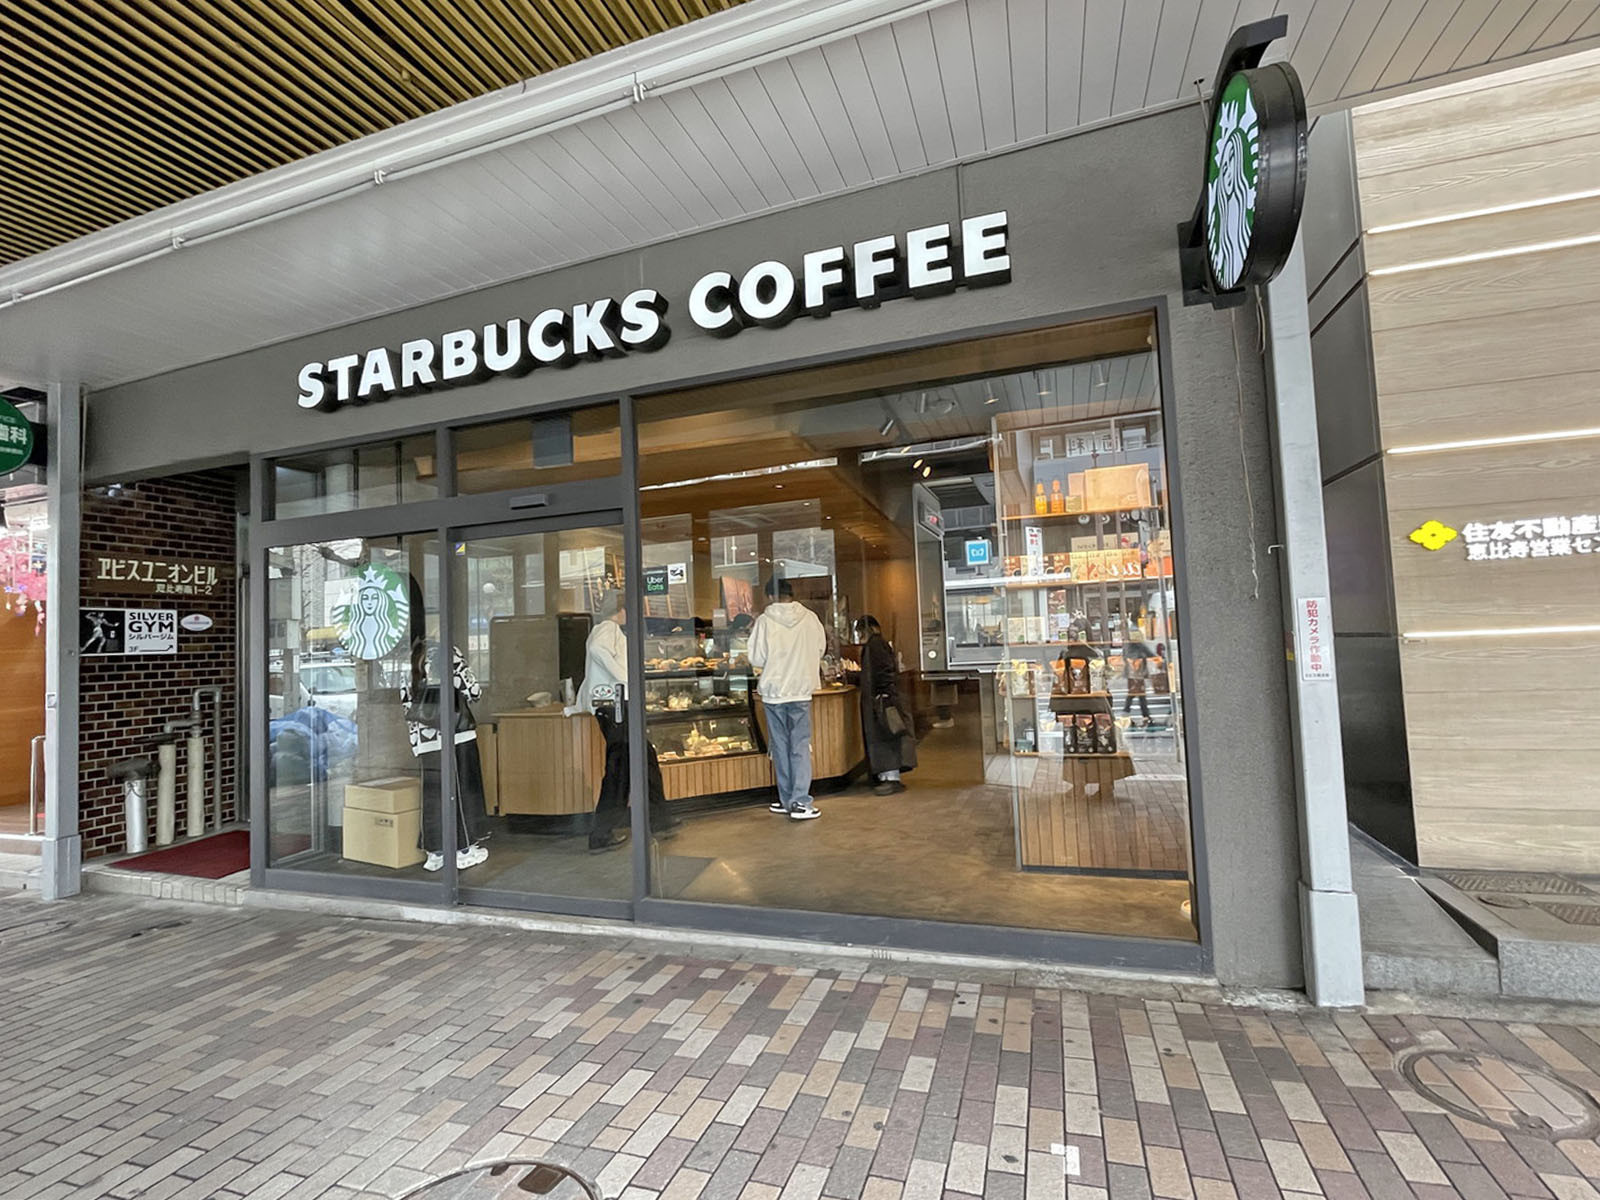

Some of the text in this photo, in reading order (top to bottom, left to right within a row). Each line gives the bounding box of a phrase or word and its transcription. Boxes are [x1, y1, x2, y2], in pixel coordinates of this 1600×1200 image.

[298, 210, 1011, 410] STARBUCKS COFFEE
[1462, 515, 1600, 543] 住友不動産
[646, 576, 664, 584] Uber
[647, 584, 664, 592] Eats
[128, 612, 174, 621] SILVER
[128, 621, 174, 633] GYM
[1306, 600, 1322, 672] 防犯カメラ作動中
